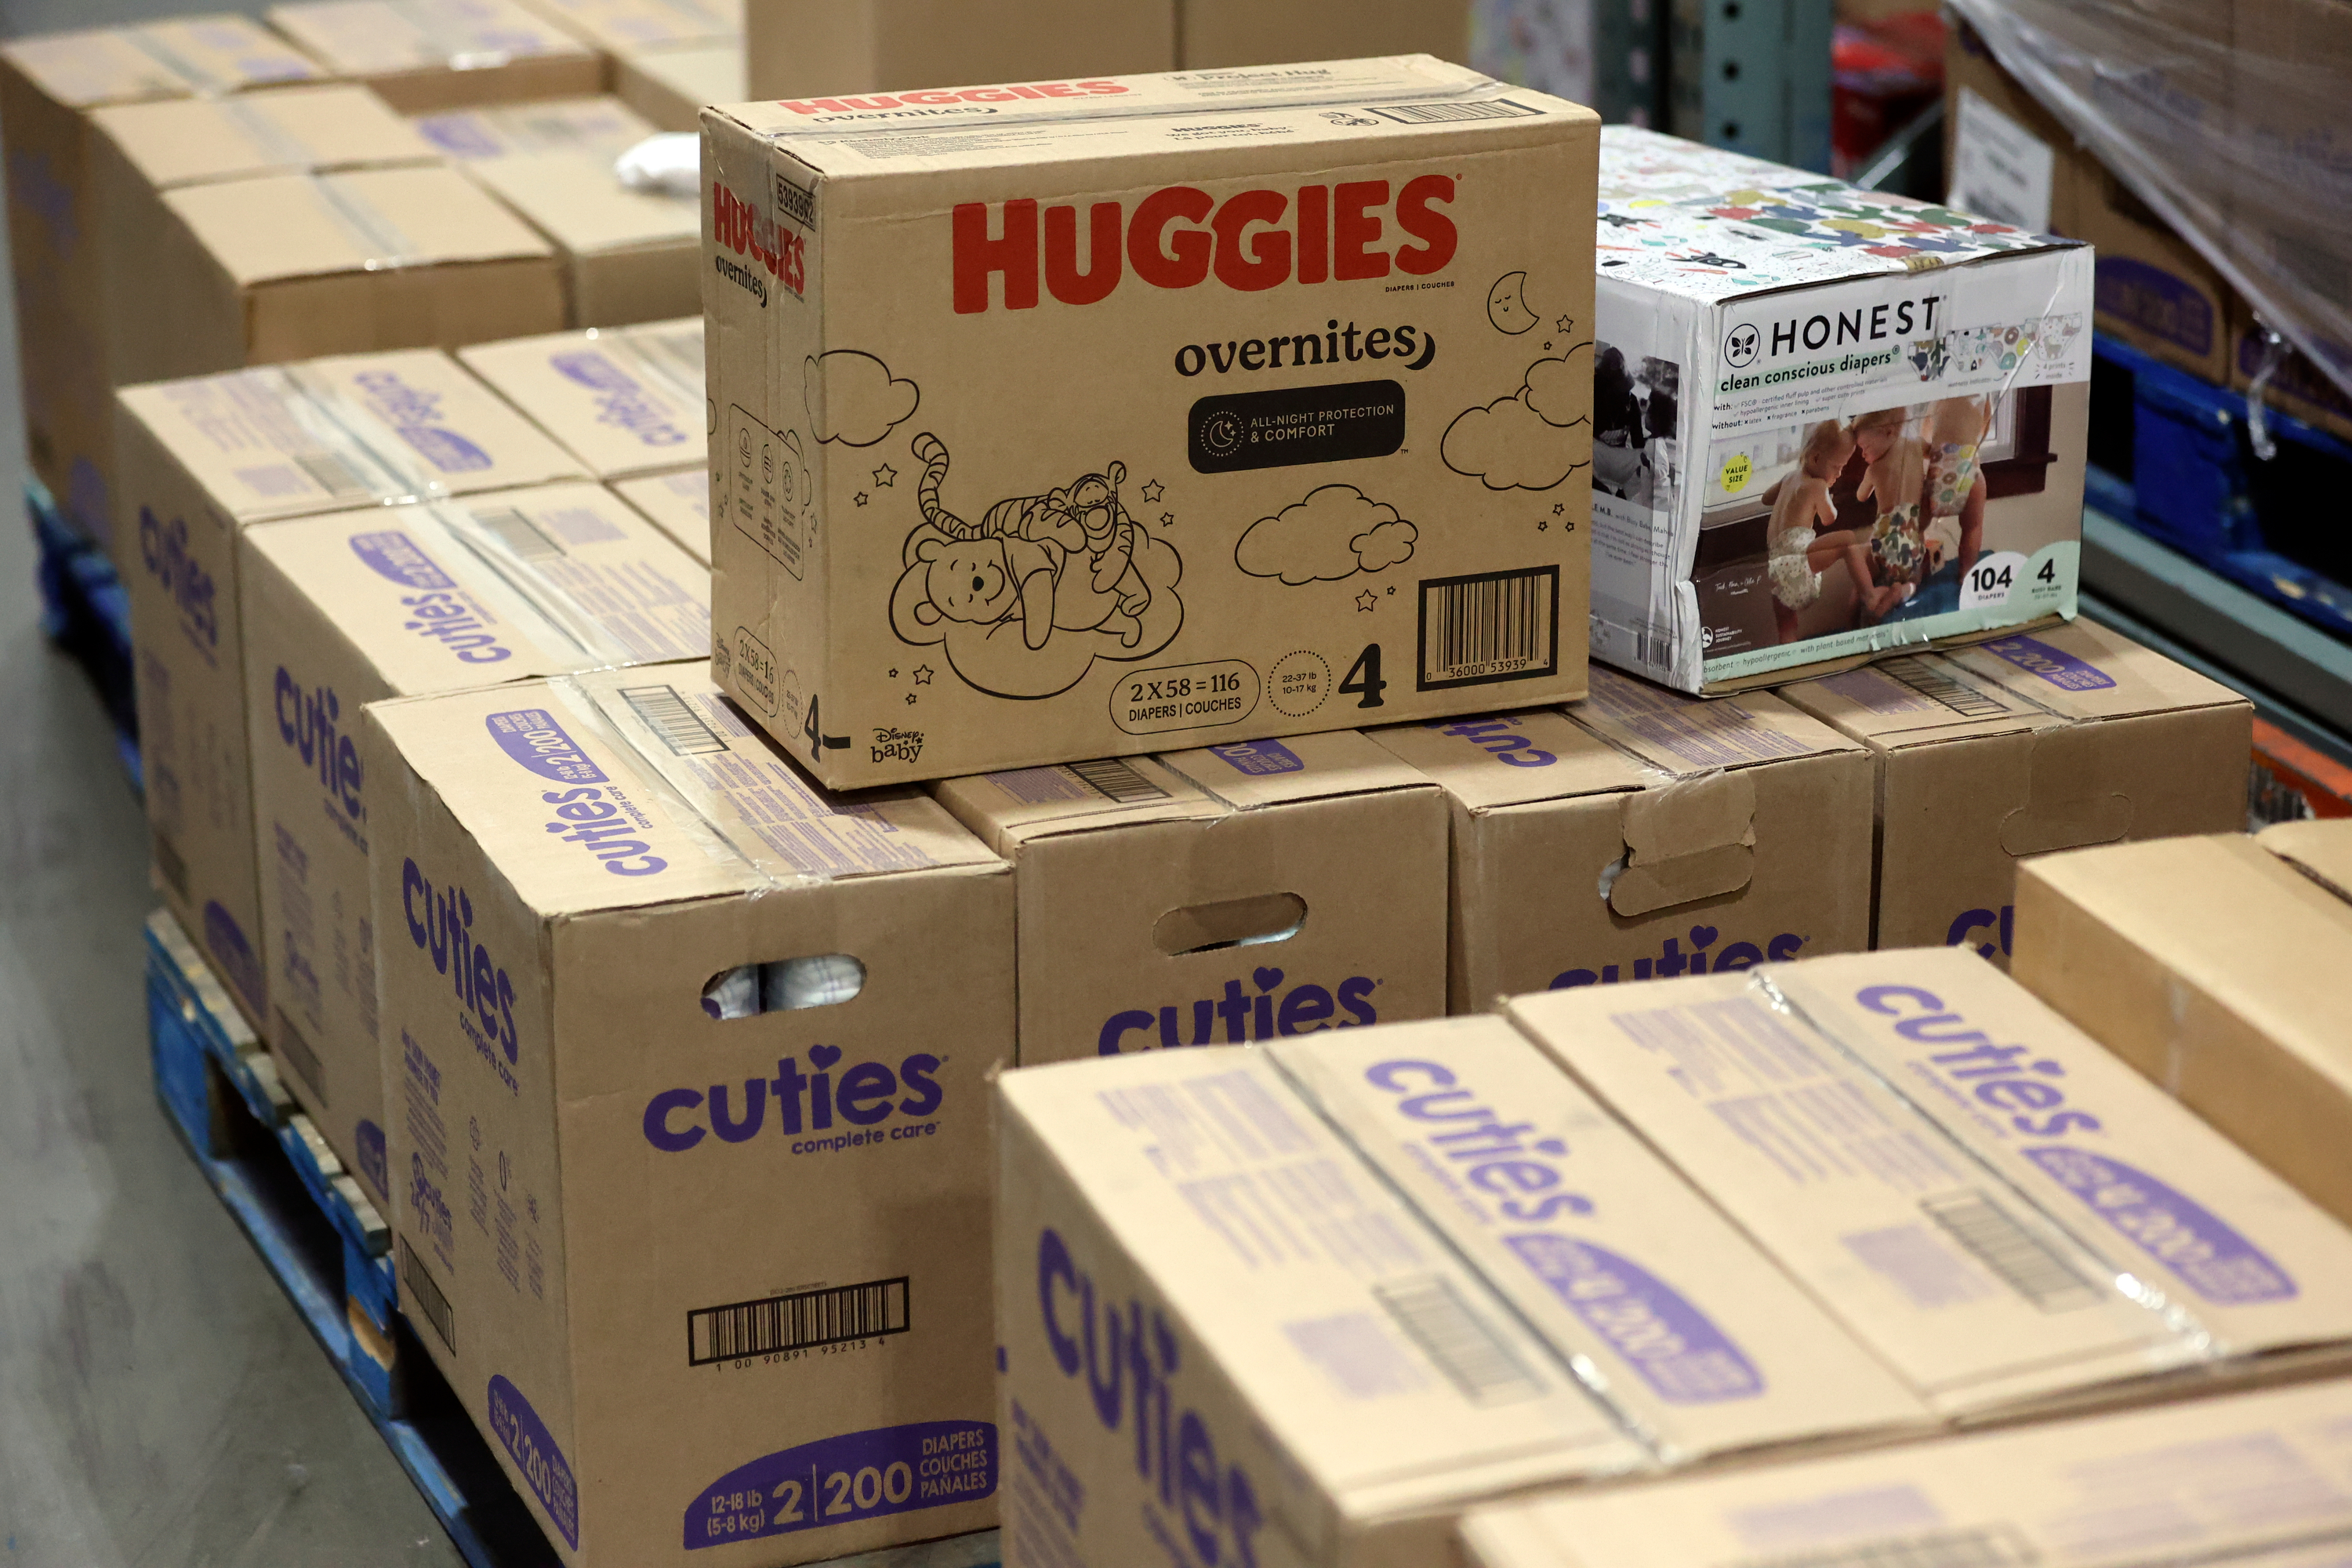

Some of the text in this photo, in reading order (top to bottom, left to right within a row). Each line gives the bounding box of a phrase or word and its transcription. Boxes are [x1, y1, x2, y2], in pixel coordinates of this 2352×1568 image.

[778, 81, 1131, 114] HUGGIES
[813, 105, 988, 123] overnites
[1171, 123, 1260, 132] HUGGIES
[953, 174, 1458, 314] HUGGIES
[716, 256, 764, 299] overnites
[1385, 280, 1455, 292] DIAPERS COUCHES
[1771, 296, 1940, 357] HONEST
[1175, 319, 1417, 376] overnites
[1720, 374, 1760, 392] clean
[1765, 361, 1835, 384] conscious
[1714, 403, 1733, 412] with:
[1762, 394, 1784, 405] certified
[1784, 391, 1798, 401] fluff
[1798, 389, 1809, 398] pulp
[1740, 404, 1779, 417] hypoallergenic
[1822, 394, 1837, 403] super
[1250, 404, 1395, 428] ALL-NIGHT PROTECTION
[1712, 419, 1744, 430] without:
[1771, 410, 1798, 422] fragrance
[1805, 405, 1830, 415] parabens
[1250, 424, 1335, 443] & COMFORT
[1726, 464, 1748, 474] VALUE
[1729, 474, 1744, 484] SIZE
[1972, 564, 2013, 593] 104
[2037, 558, 2056, 584] 4
[1978, 592, 2005, 601] DIAPERS
[1448, 664, 1485, 678] 36000
[1490, 659, 1526, 673] 53939
[1743, 649, 1791, 666] hypoallergenic
[1800, 644, 1815, 654] with
[2009, 652, 2067, 673] 200
[1283, 673, 1306, 683] 22-37
[1283, 684, 1316, 694] 10-17 kg
[1338, 643, 1387, 709] 4
[1130, 697, 1241, 721] DIAPERS COUCHES
[804, 694, 822, 764] 4
[873, 728, 920, 743] Disney
[275, 666, 367, 822] cutie
[523, 730, 583, 765] 2 200
[870, 743, 924, 764] baby
[605, 785, 654, 829] complete care
[542, 788, 668, 877] cuties
[403, 857, 518, 1066] cuties
[459, 1011, 519, 1098] complete care
[1856, 985, 2103, 1137] cuties
[643, 1045, 945, 1152] cuties
[792, 1121, 936, 1155] complete care
[1365, 1058, 1596, 1223] cuties
[716, 1336, 885, 1373] 1 00 90891 95213 4
[922, 1428, 985, 1456] DIAPERS
[511, 1414, 552, 1505] 2 200
[920, 1450, 988, 1478] COUCHES
[772, 1461, 913, 1526] 2 200
[920, 1470, 988, 1499] PAÑALES
[711, 1489, 762, 1515] 12-18 lb
[707, 1508, 765, 1537] (5-8 kg)
